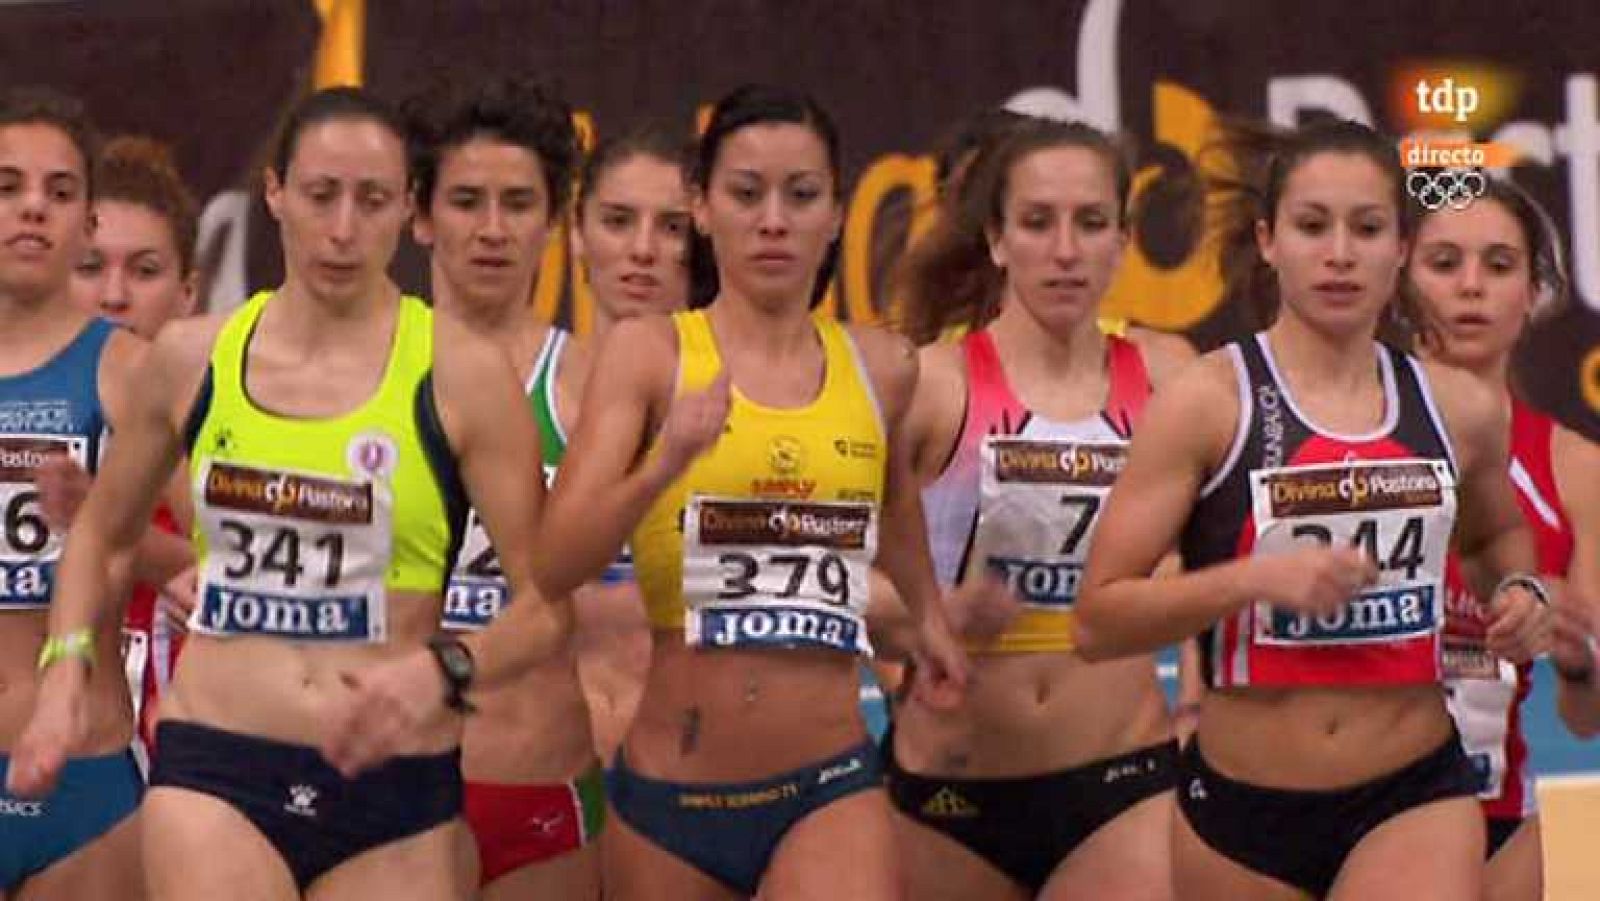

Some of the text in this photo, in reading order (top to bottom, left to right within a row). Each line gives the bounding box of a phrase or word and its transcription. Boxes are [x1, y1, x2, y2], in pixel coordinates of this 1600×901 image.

[1001, 450, 1057, 469] Divina
[210, 470, 265, 496] Divina
[299, 486, 368, 509] Pastora
[1274, 480, 1334, 502] Divina
[1369, 472, 1437, 494] Pastora
[703, 507, 764, 531] Divina
[1059, 495, 1101, 555] 7
[220, 519, 345, 588] 341
[715, 552, 850, 606] 379
